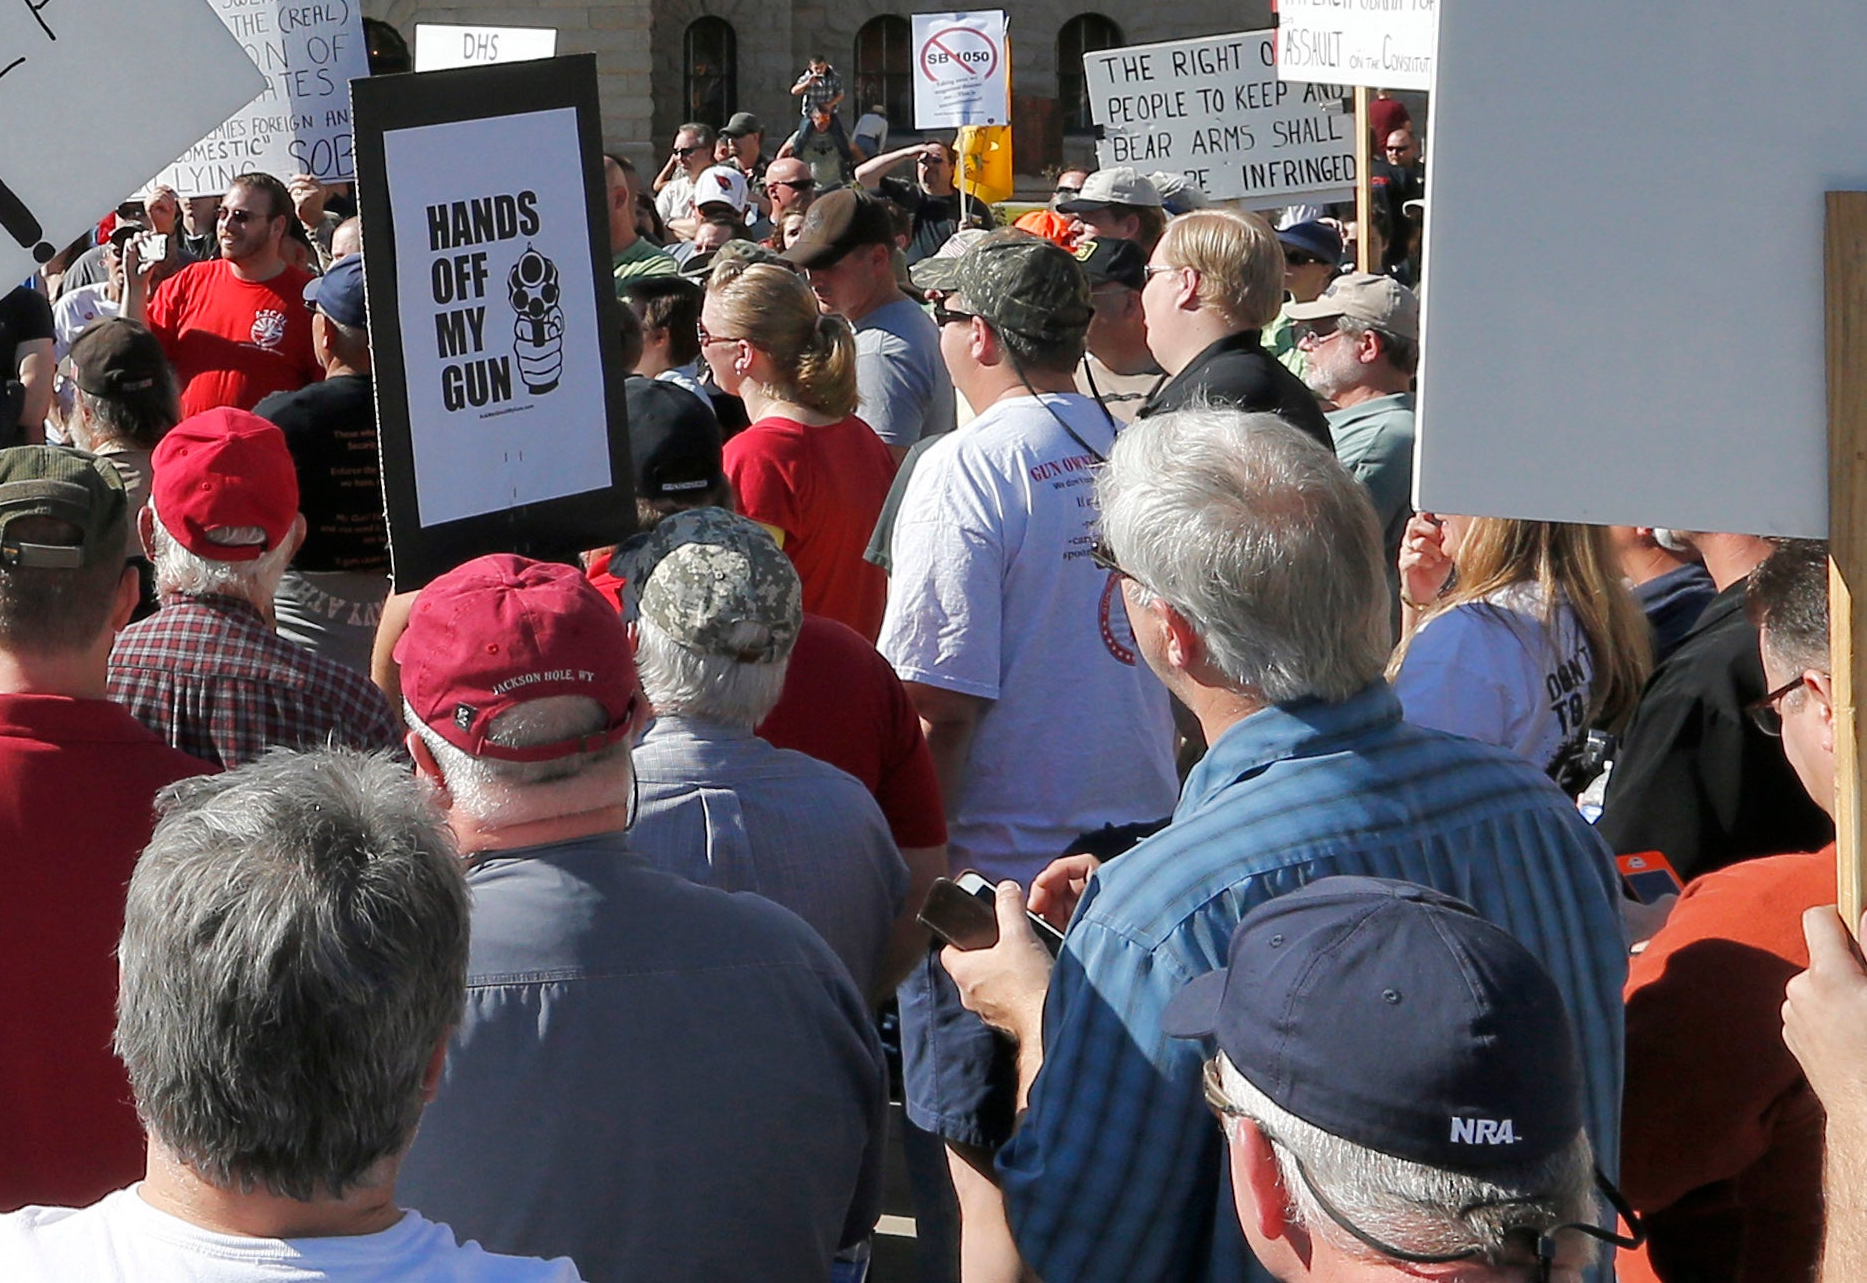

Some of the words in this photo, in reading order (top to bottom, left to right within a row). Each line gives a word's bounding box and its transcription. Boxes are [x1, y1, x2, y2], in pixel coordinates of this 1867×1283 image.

[229, 10, 270, 38] THE
[243, 38, 289, 70] ON
[306, 33, 349, 65] OF
[462, 32, 500, 62] DHS
[927, 52, 949, 65] SB
[1099, 54, 1155, 84] THE
[1172, 43, 1243, 77] RIGHT
[1260, 40, 1277, 67] O
[1284, 28, 1343, 68] ASSAULT
[1382, 33, 1431, 73] CONSTITUT
[253, 67, 335, 103] ATES
[1107, 90, 1188, 123] PEOPLE
[1196, 88, 1225, 114] TO
[1235, 80, 1288, 111] KEEP
[252, 114, 313, 134] FOREIGN
[325, 108, 349, 128] AN
[1113, 131, 1173, 163] BEAR
[1191, 124, 1256, 156] ARMS
[1272, 115, 1344, 149] SHALL
[1242, 153, 1357, 191] INFRINGED
[425, 189, 541, 253] HANDS
[430, 251, 490, 306] OFF
[434, 305, 486, 360] MY
[441, 354, 513, 414] GUN
[1030, 460, 1062, 482] GUN
[492, 672, 541, 696] JACKSON
[544, 668, 575, 682] HOLE,
[578, 669, 595, 683] WY
[1450, 1116, 1515, 1145] NRA
